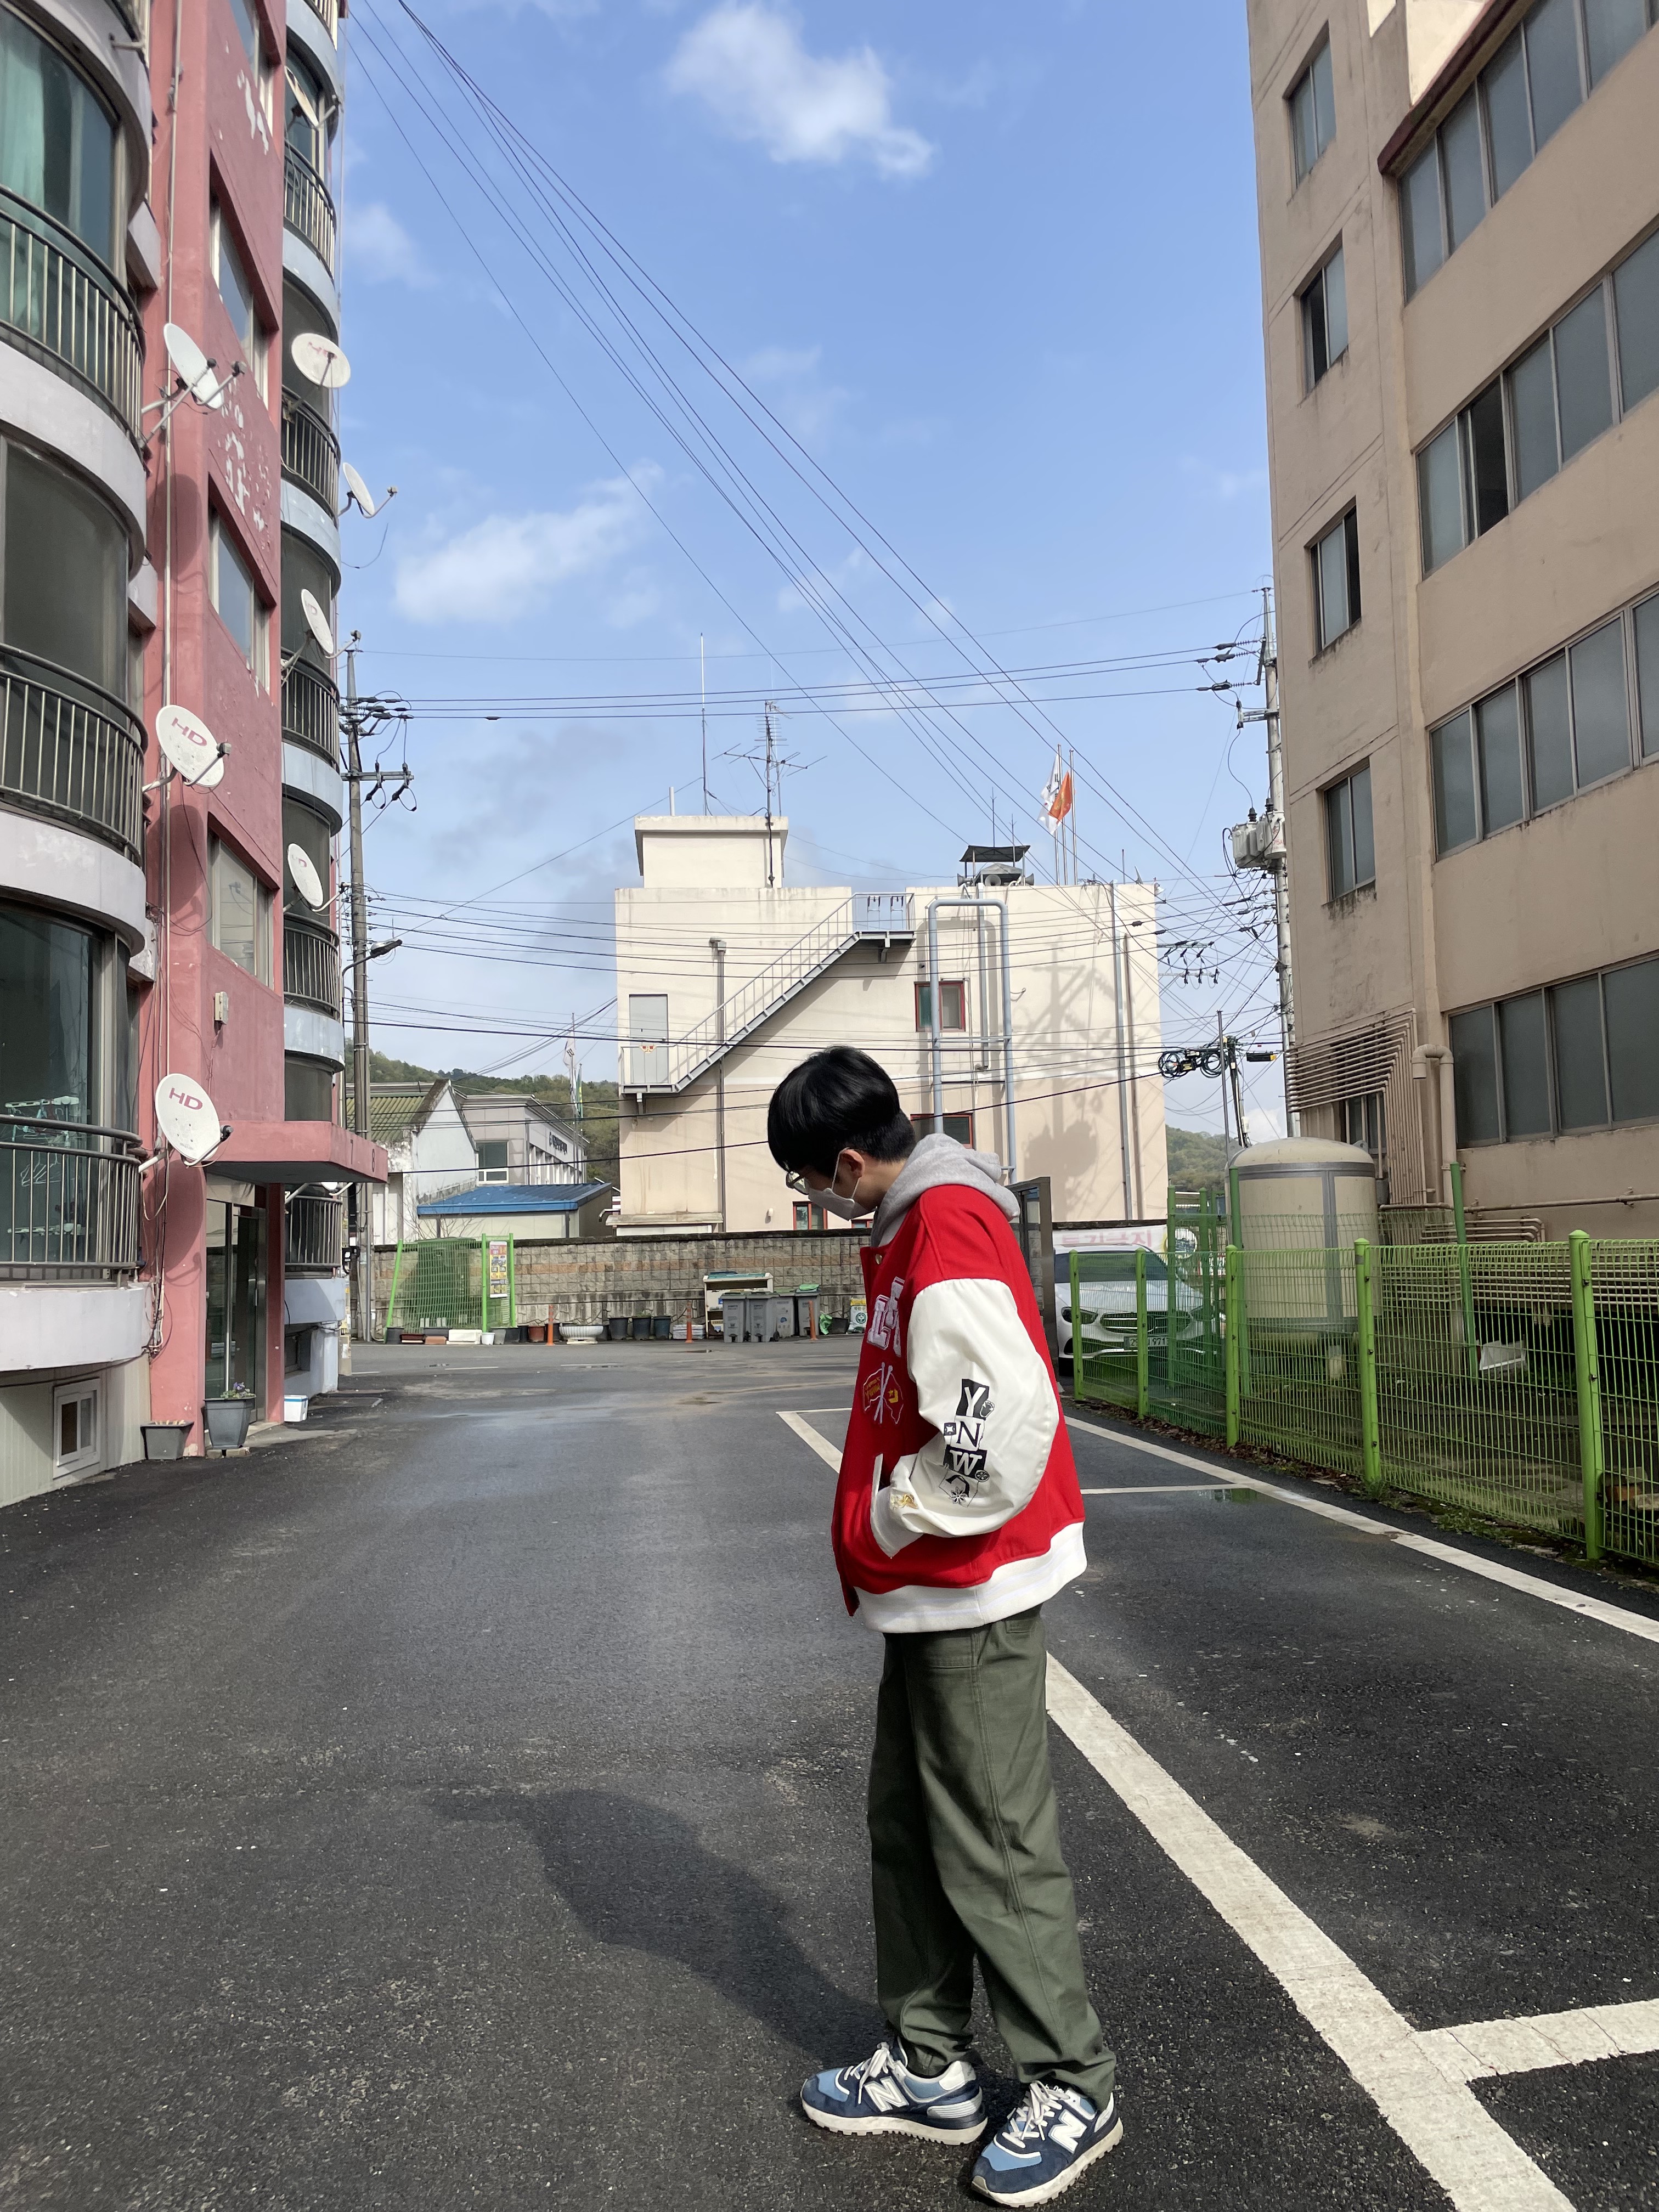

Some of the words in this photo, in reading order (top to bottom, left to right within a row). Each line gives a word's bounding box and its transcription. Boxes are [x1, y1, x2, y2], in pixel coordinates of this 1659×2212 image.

[171, 716, 207, 747] HD
[168, 1087, 203, 1110] HD
[863, 2075, 910, 2113] N
[1047, 2108, 1088, 2154] N
